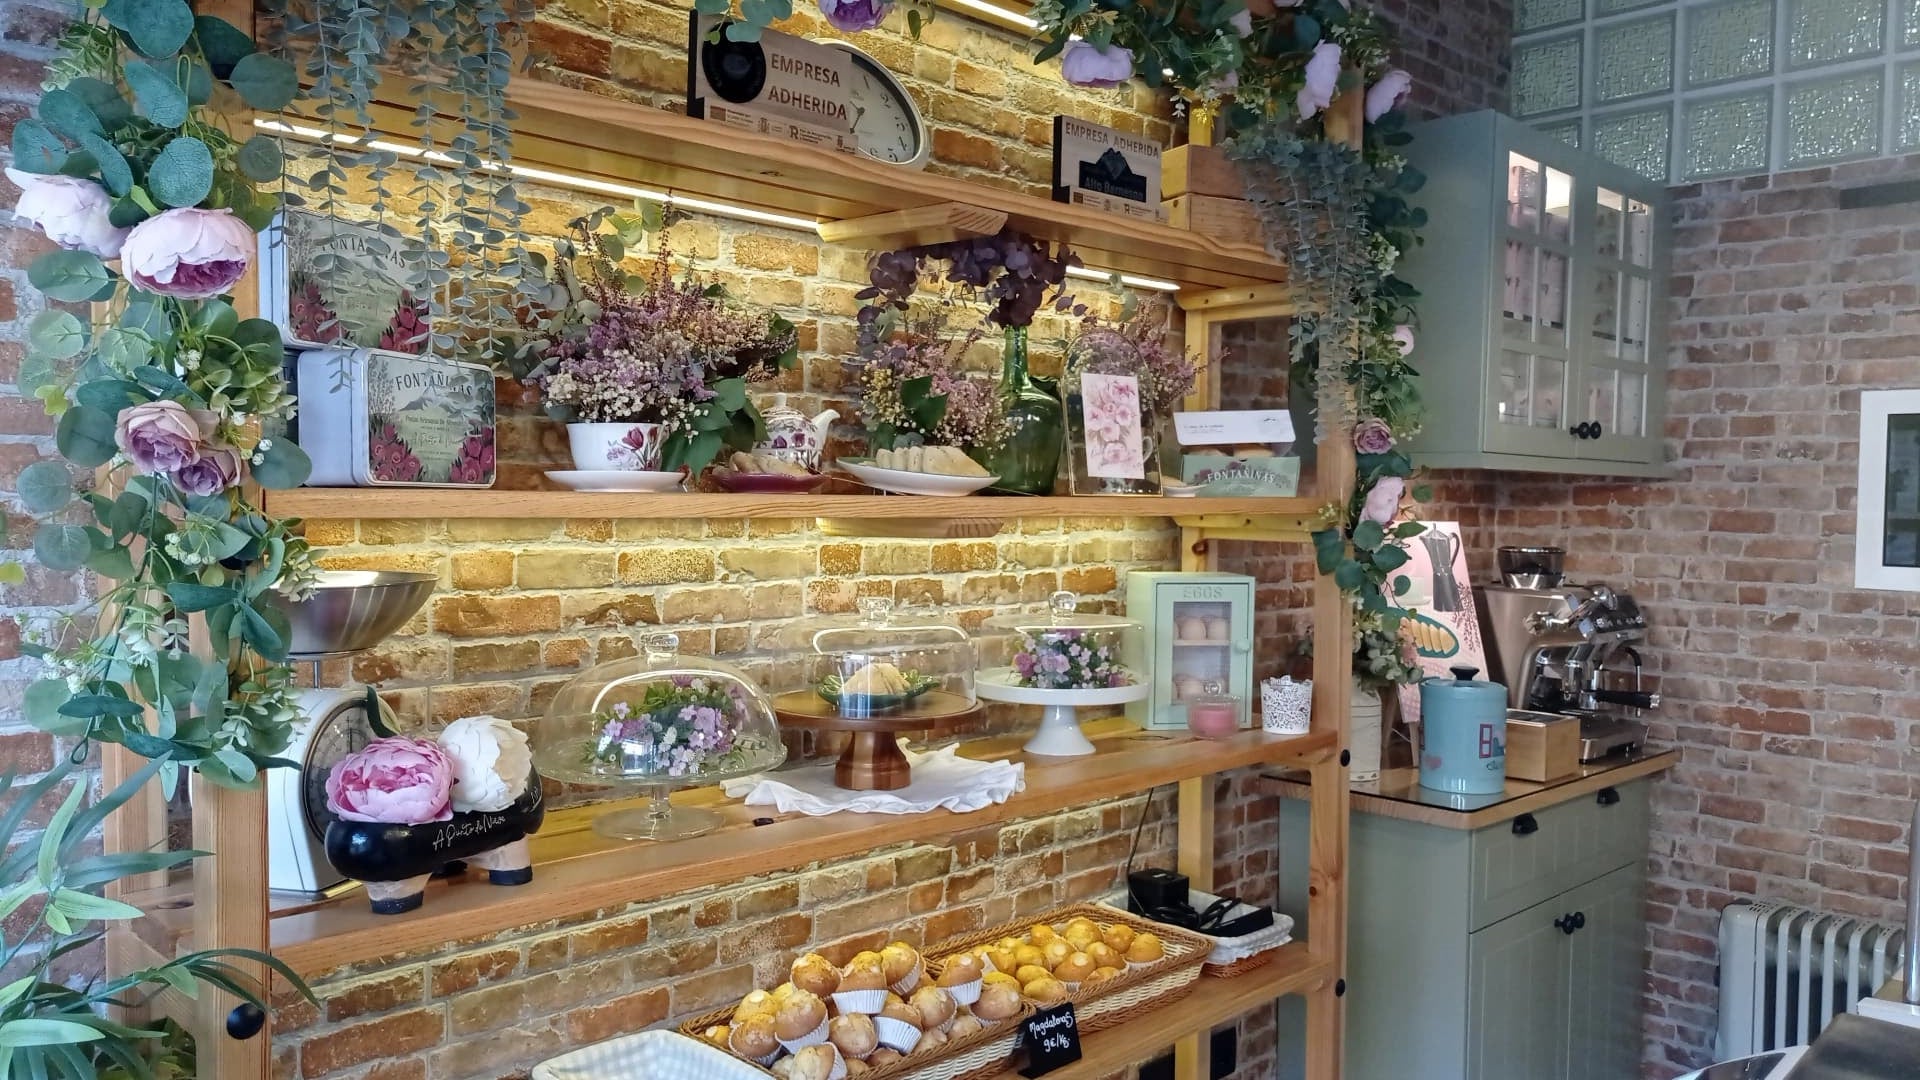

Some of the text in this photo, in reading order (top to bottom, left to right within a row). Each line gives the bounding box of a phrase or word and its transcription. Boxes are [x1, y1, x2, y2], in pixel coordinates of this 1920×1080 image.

[771, 53, 841, 87] EMPRESA
[768, 85, 847, 120] ADHERIDA
[1065, 122, 1160, 159] EMPRESA ADHERIDA
[1183, 586, 1223, 599] EGGS
[432, 828, 444, 851] A
